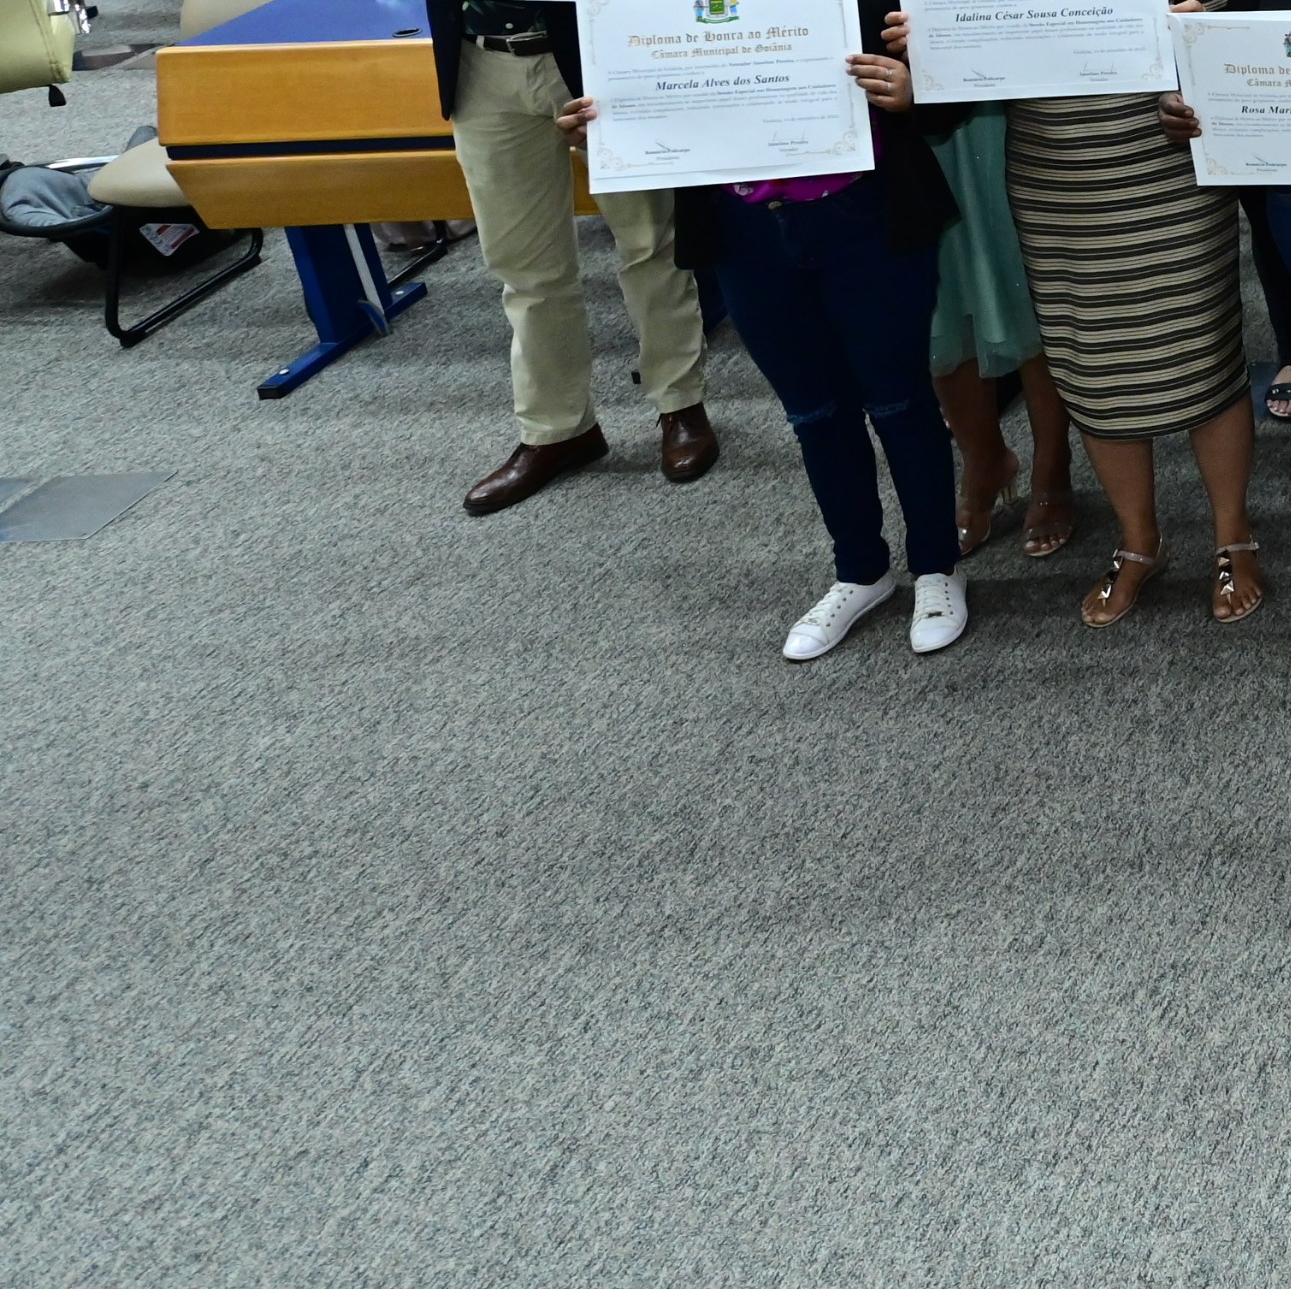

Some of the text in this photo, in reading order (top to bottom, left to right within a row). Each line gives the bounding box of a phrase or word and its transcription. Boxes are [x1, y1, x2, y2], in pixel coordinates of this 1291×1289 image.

[955, 7, 1113, 22] Idalina César Sousa Conceição
[627, 27, 808, 45] Diploma de Honra ao Mérito
[1224, 64, 1274, 75] Diploma
[1278, 66, 1290, 75] de
[656, 75, 789, 90] Marcela Alves dos Santos
